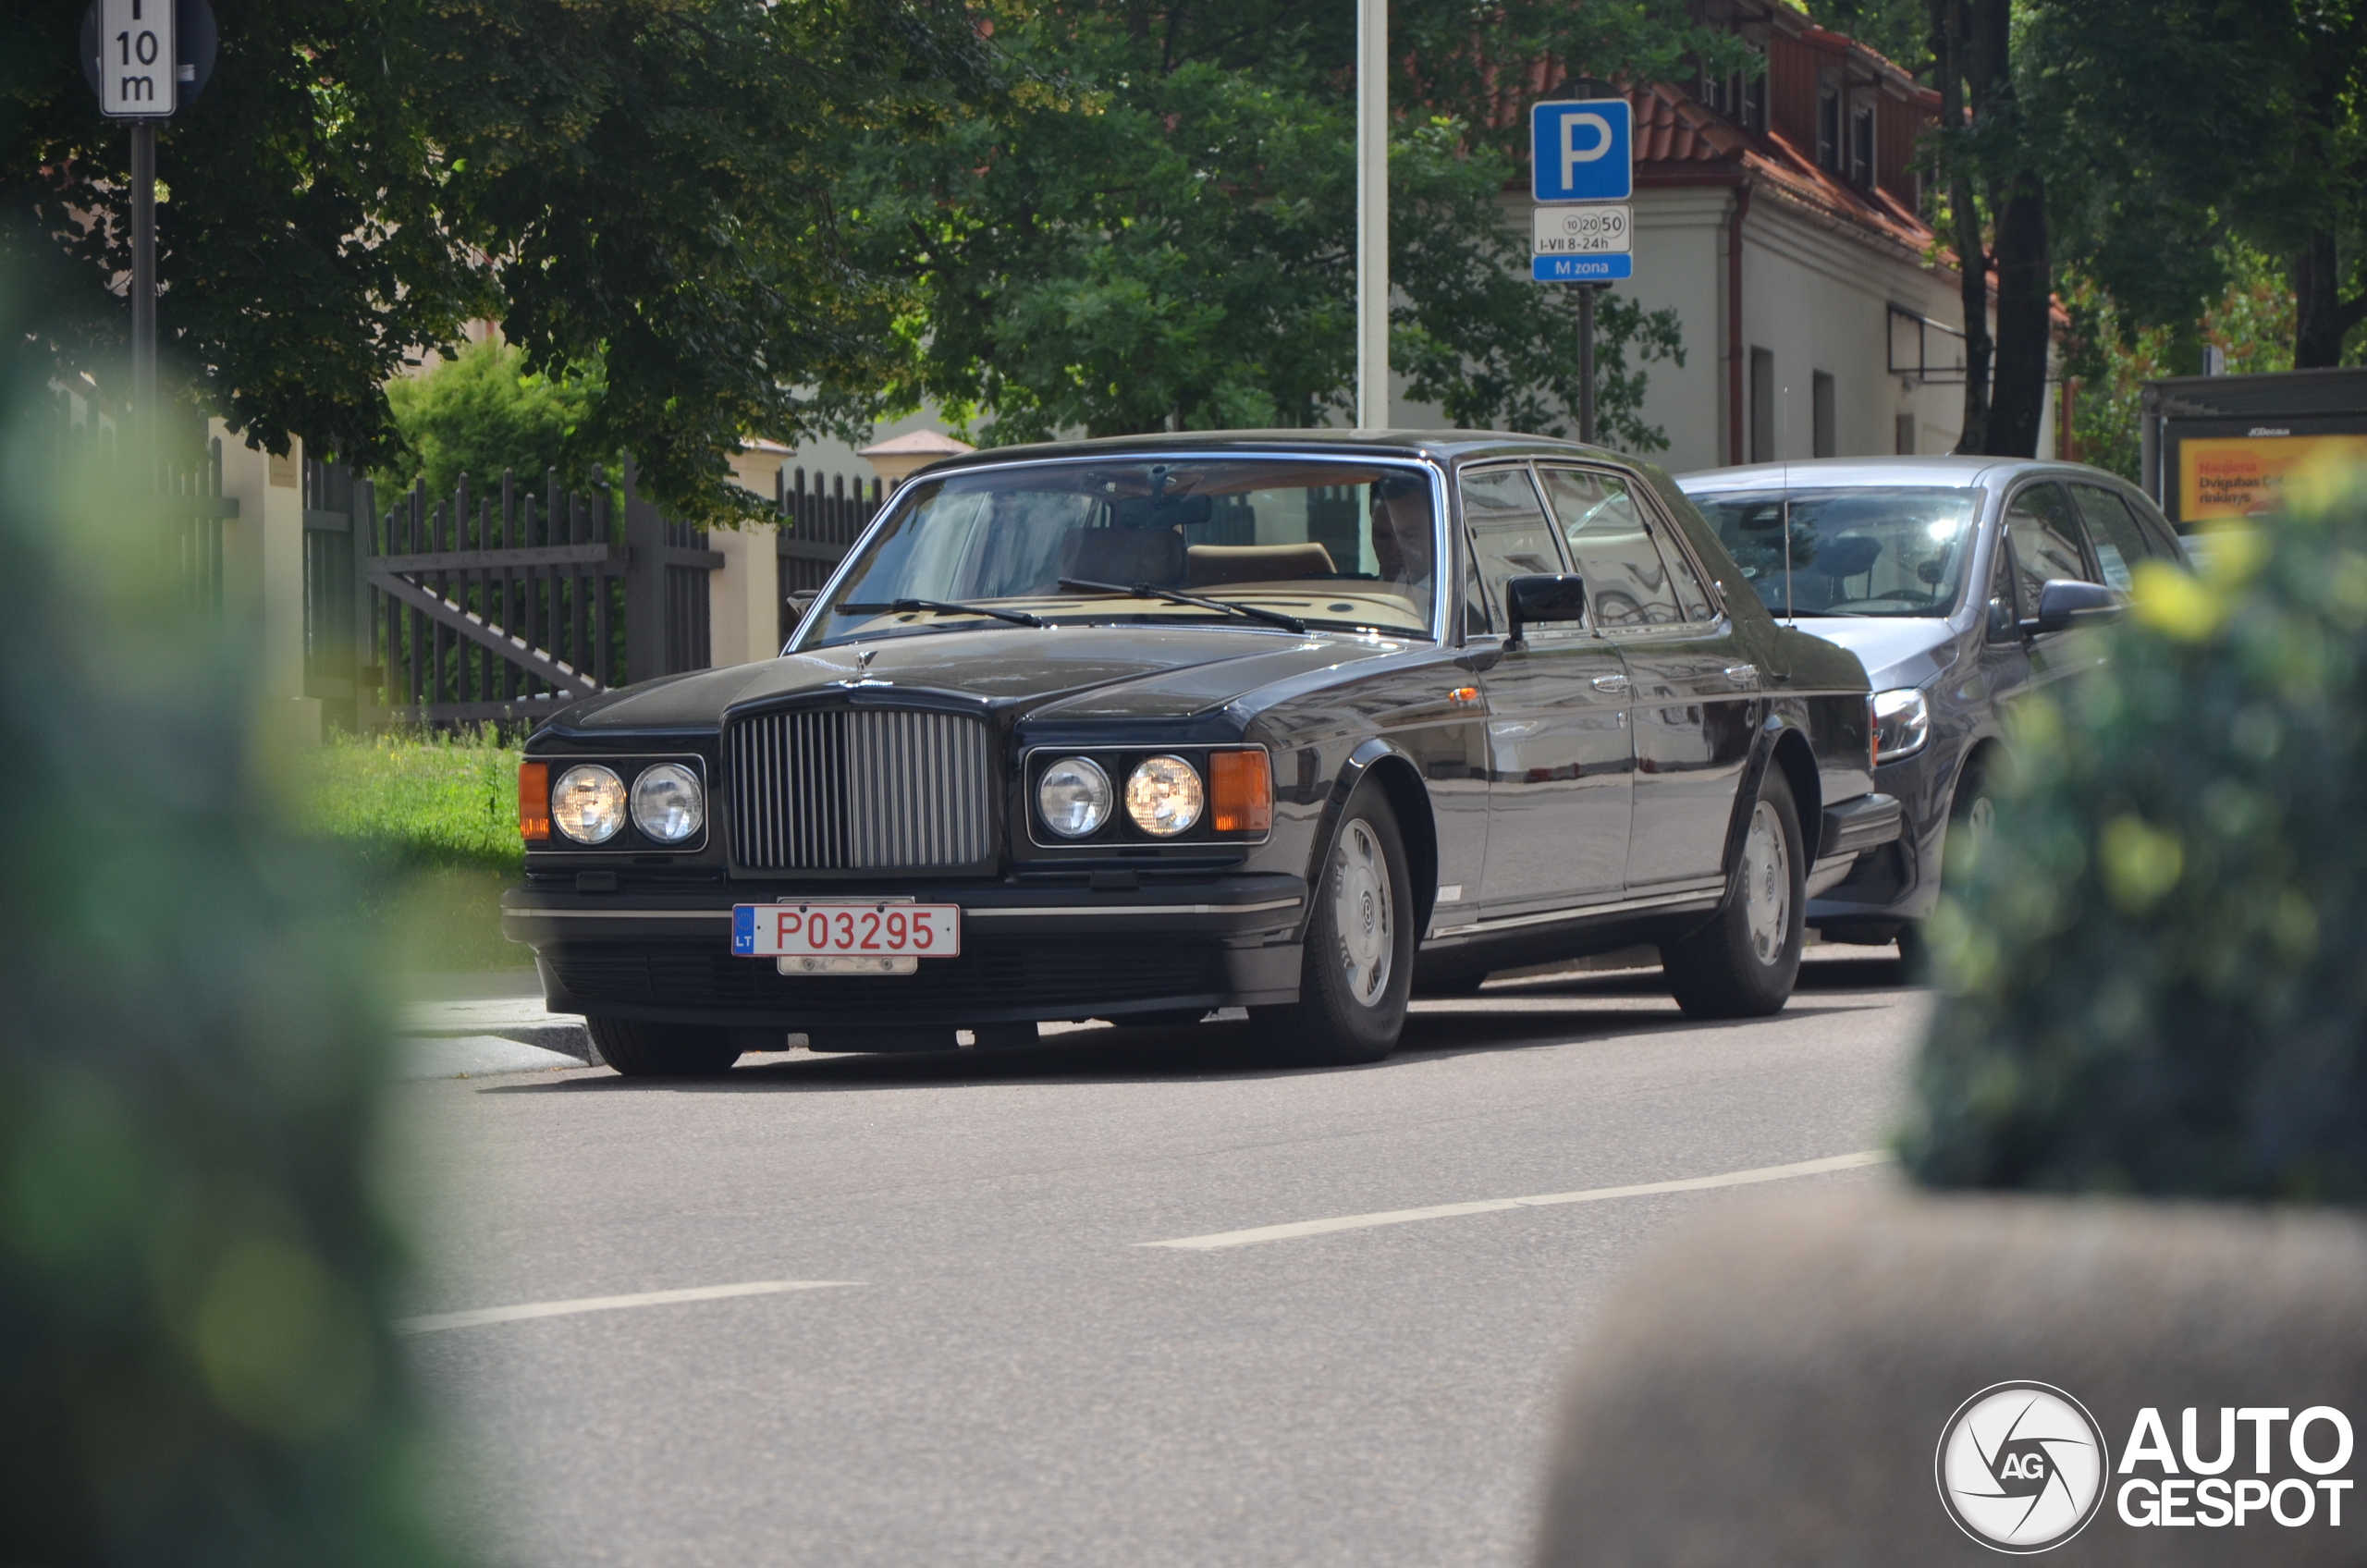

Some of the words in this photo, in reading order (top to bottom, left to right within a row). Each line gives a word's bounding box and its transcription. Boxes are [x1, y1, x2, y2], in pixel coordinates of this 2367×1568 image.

[117, 30, 158, 66] 10
[121, 76, 153, 102] m
[1560, 112, 1613, 190] P
[1567, 220, 1577, 229] 10
[1582, 218, 1598, 230] 20
[1602, 216, 1622, 231] 50
[1540, 239, 1564, 251] I-VII
[1555, 261, 1571, 275] M
[1575, 262, 1609, 274] zona
[2199, 475, 2260, 493] Dvigubas
[777, 912, 933, 949] P03295
[735, 936, 753, 948] LT
